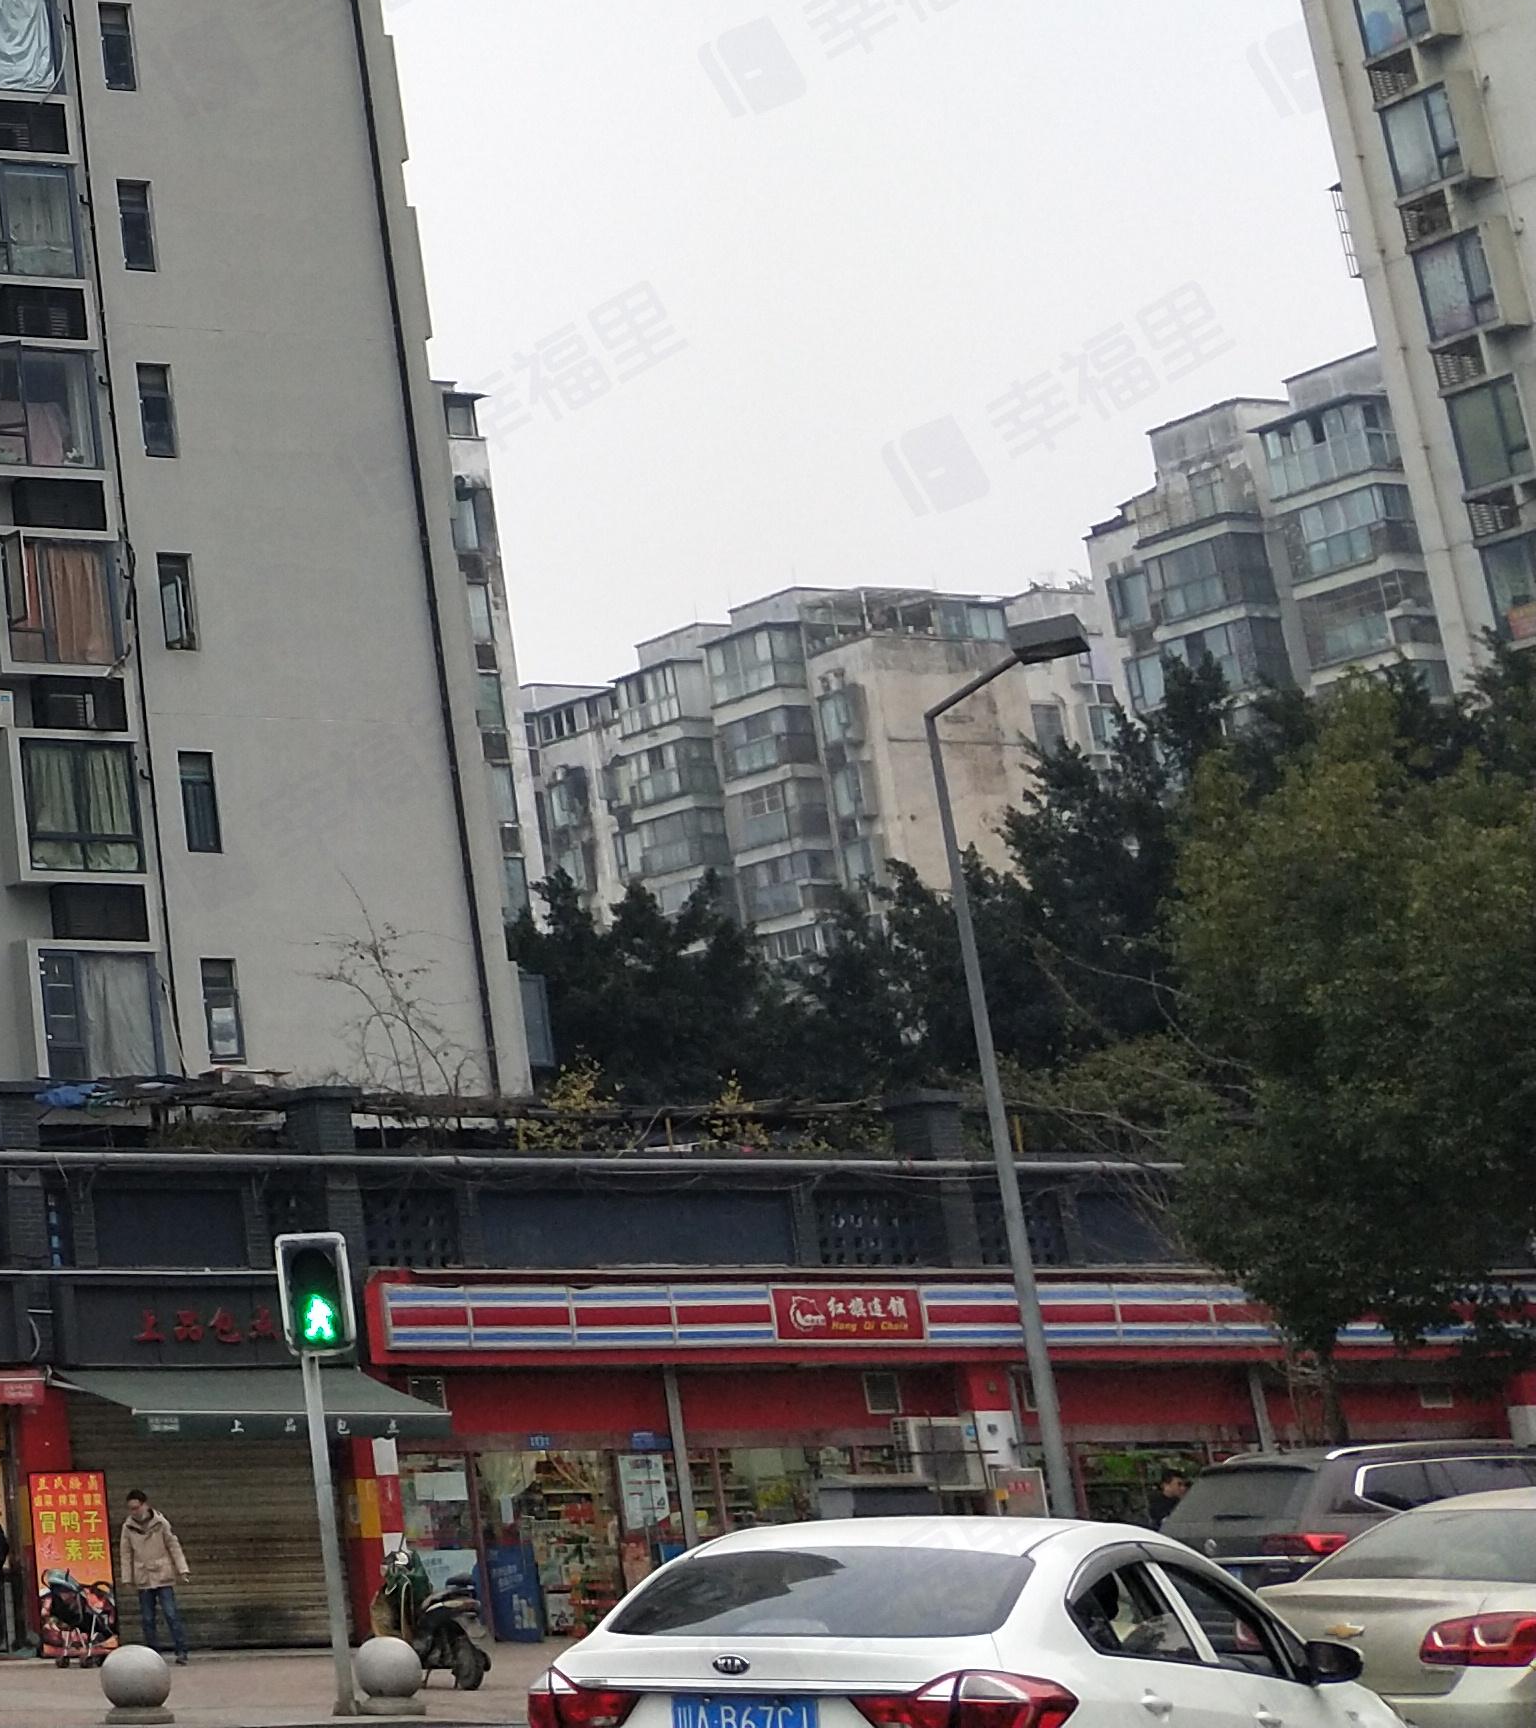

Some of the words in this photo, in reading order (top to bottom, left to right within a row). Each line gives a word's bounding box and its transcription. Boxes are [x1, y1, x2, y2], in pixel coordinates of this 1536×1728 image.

[827, 1296, 908, 1318] 红旗连锁
[133, 1306, 280, 1343] 上品包点
[39, 1510, 102, 1534] 冒鸭子
[717, 1658, 744, 1672] KIA
